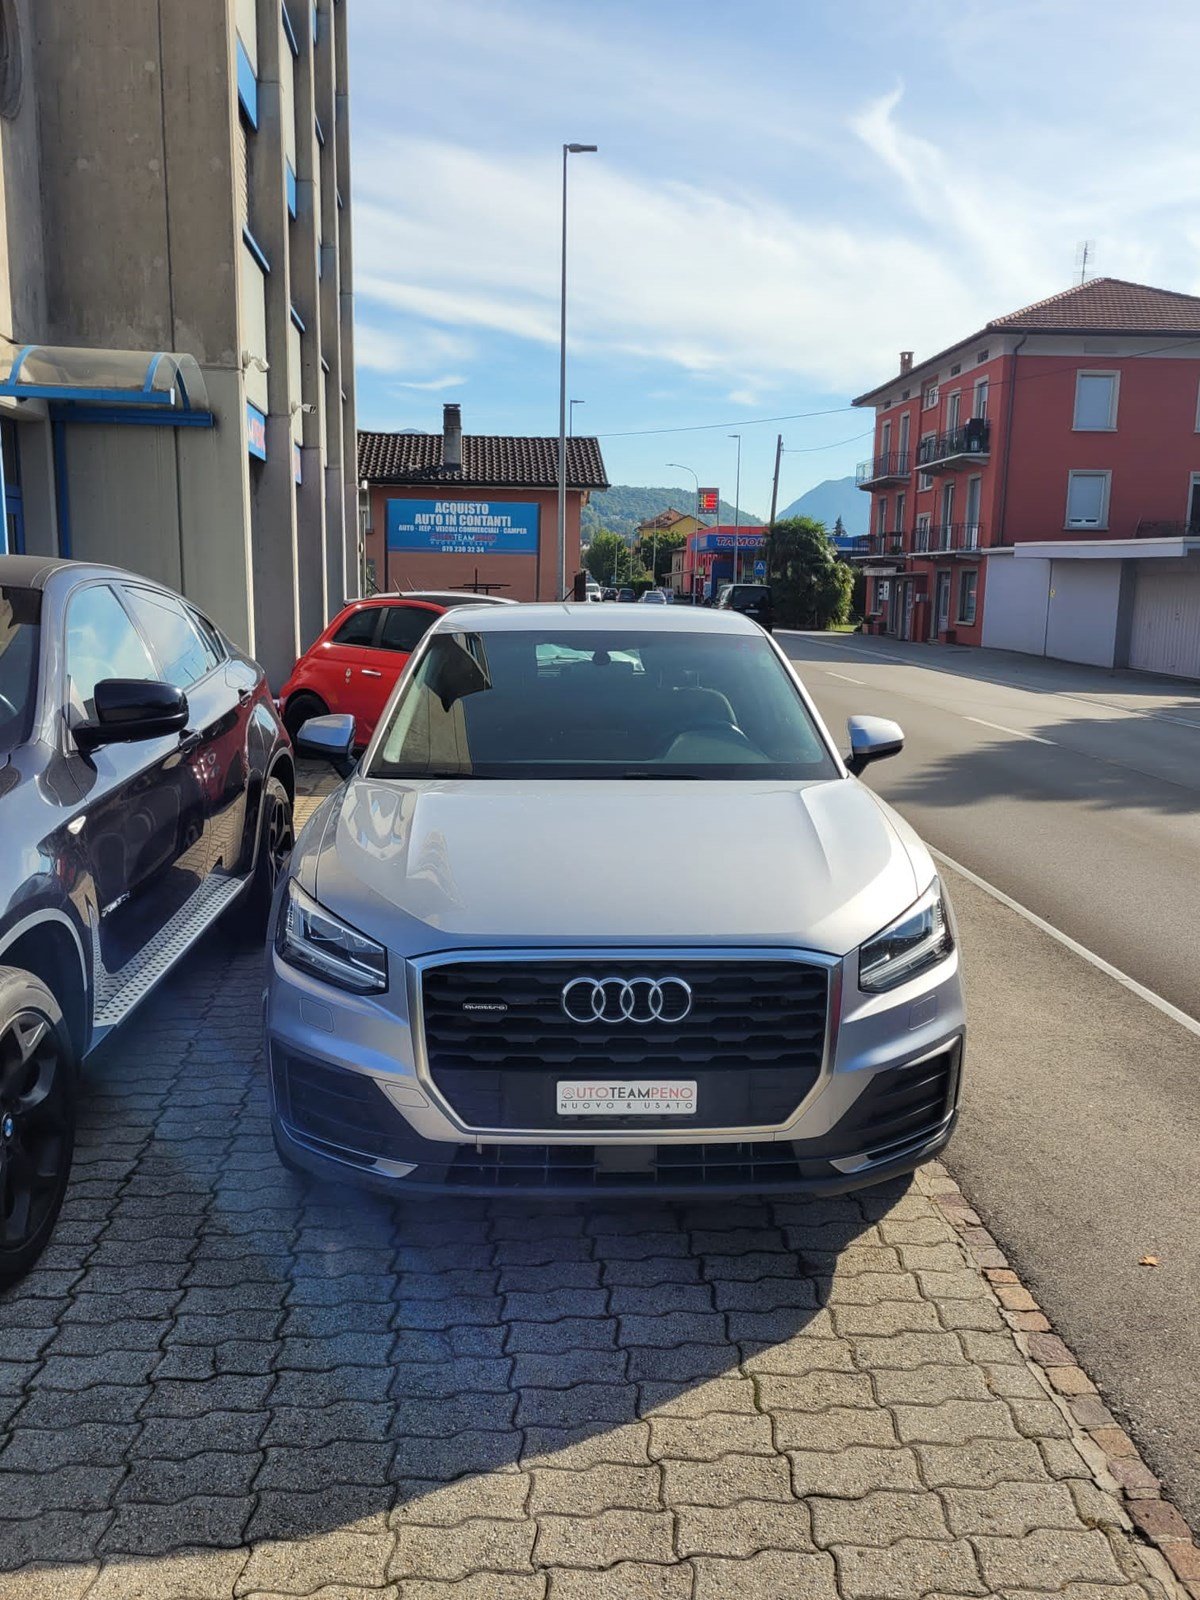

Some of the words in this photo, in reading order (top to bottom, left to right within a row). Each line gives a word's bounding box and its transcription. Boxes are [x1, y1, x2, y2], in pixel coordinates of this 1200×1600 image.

[435, 502, 489, 514] ACQUISTO
[415, 513, 445, 525] AUTO
[446, 514, 457, 525] IN
[459, 515, 511, 527] CONTANTI
